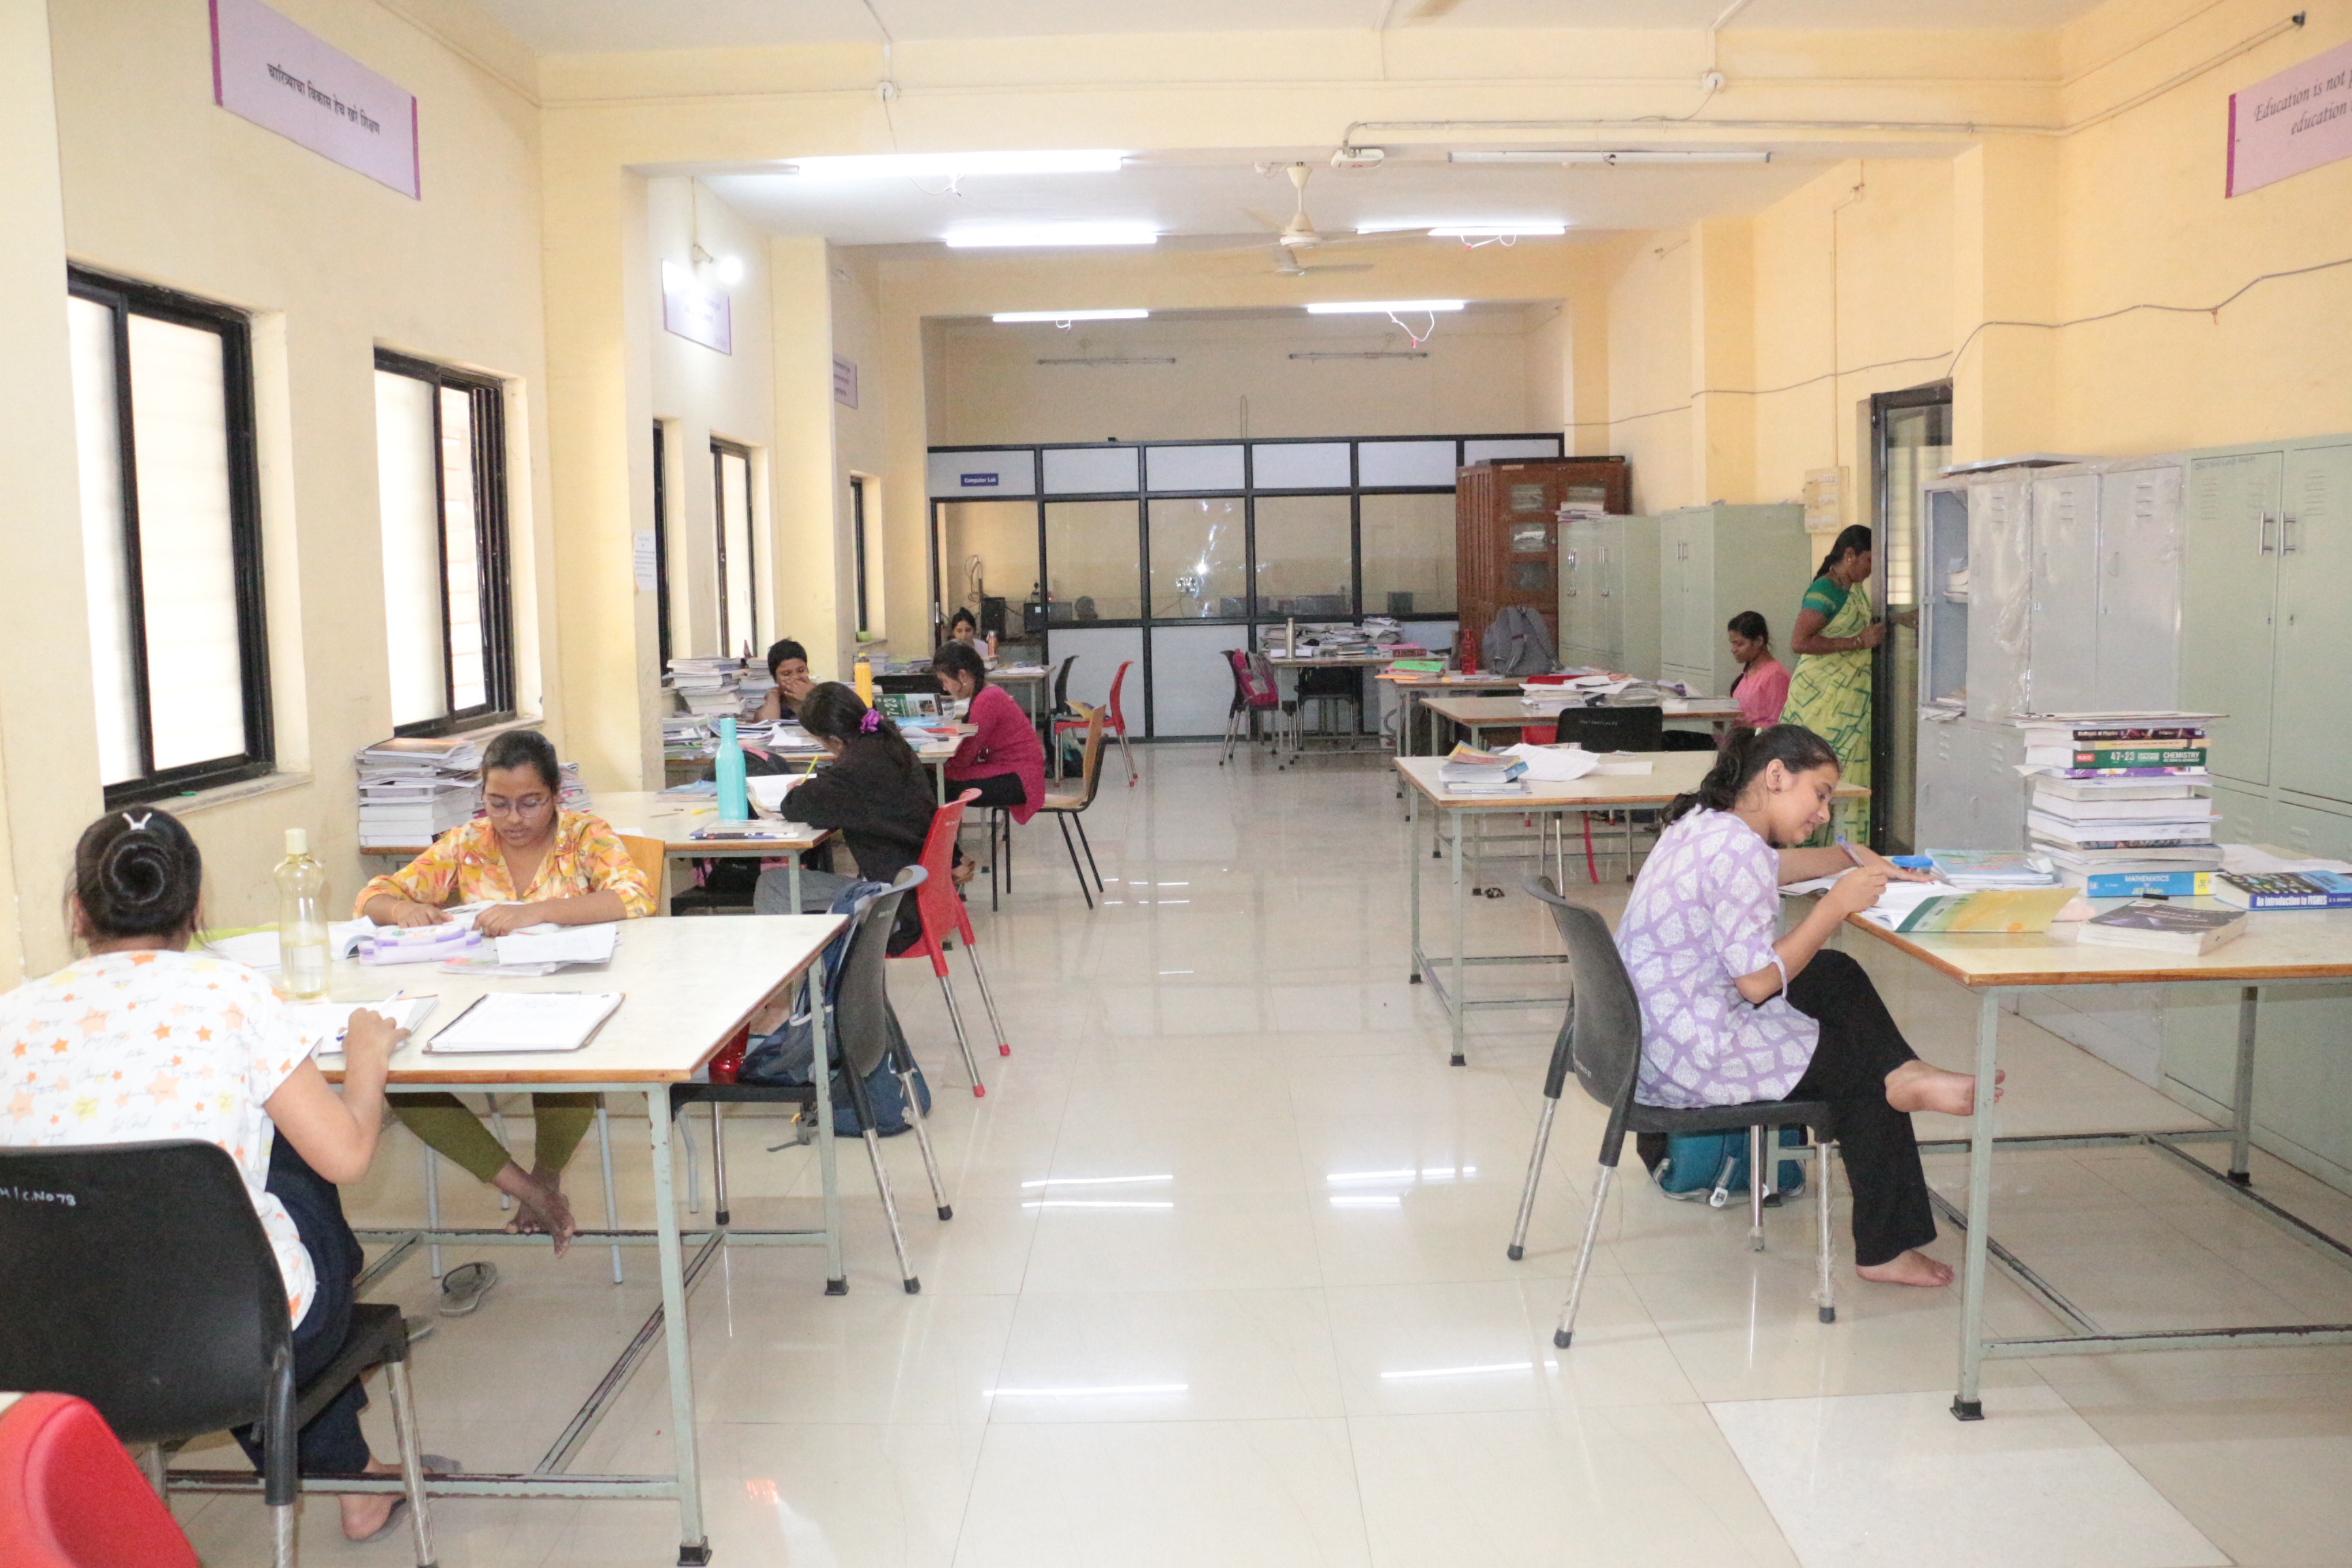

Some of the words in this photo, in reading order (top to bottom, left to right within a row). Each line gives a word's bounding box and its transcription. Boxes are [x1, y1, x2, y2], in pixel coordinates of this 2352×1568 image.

[308, 80, 331, 110] विकास
[333, 94, 345, 116] हेच
[347, 105, 358, 124] खरे
[360, 109, 380, 135] शिक्षण
[2255, 87, 2309, 122] Education
[2313, 78, 2323, 97] is
[2326, 70, 2345, 91] not
[2291, 101, 2347, 135] education
[883, 698, 900, 717] 7+23
[2198, 879, 2206, 889] 3e
[2256, 896, 2264, 906] An
[2301, 896, 2307, 905] to
[2308, 895, 2328, 905] FISHES
